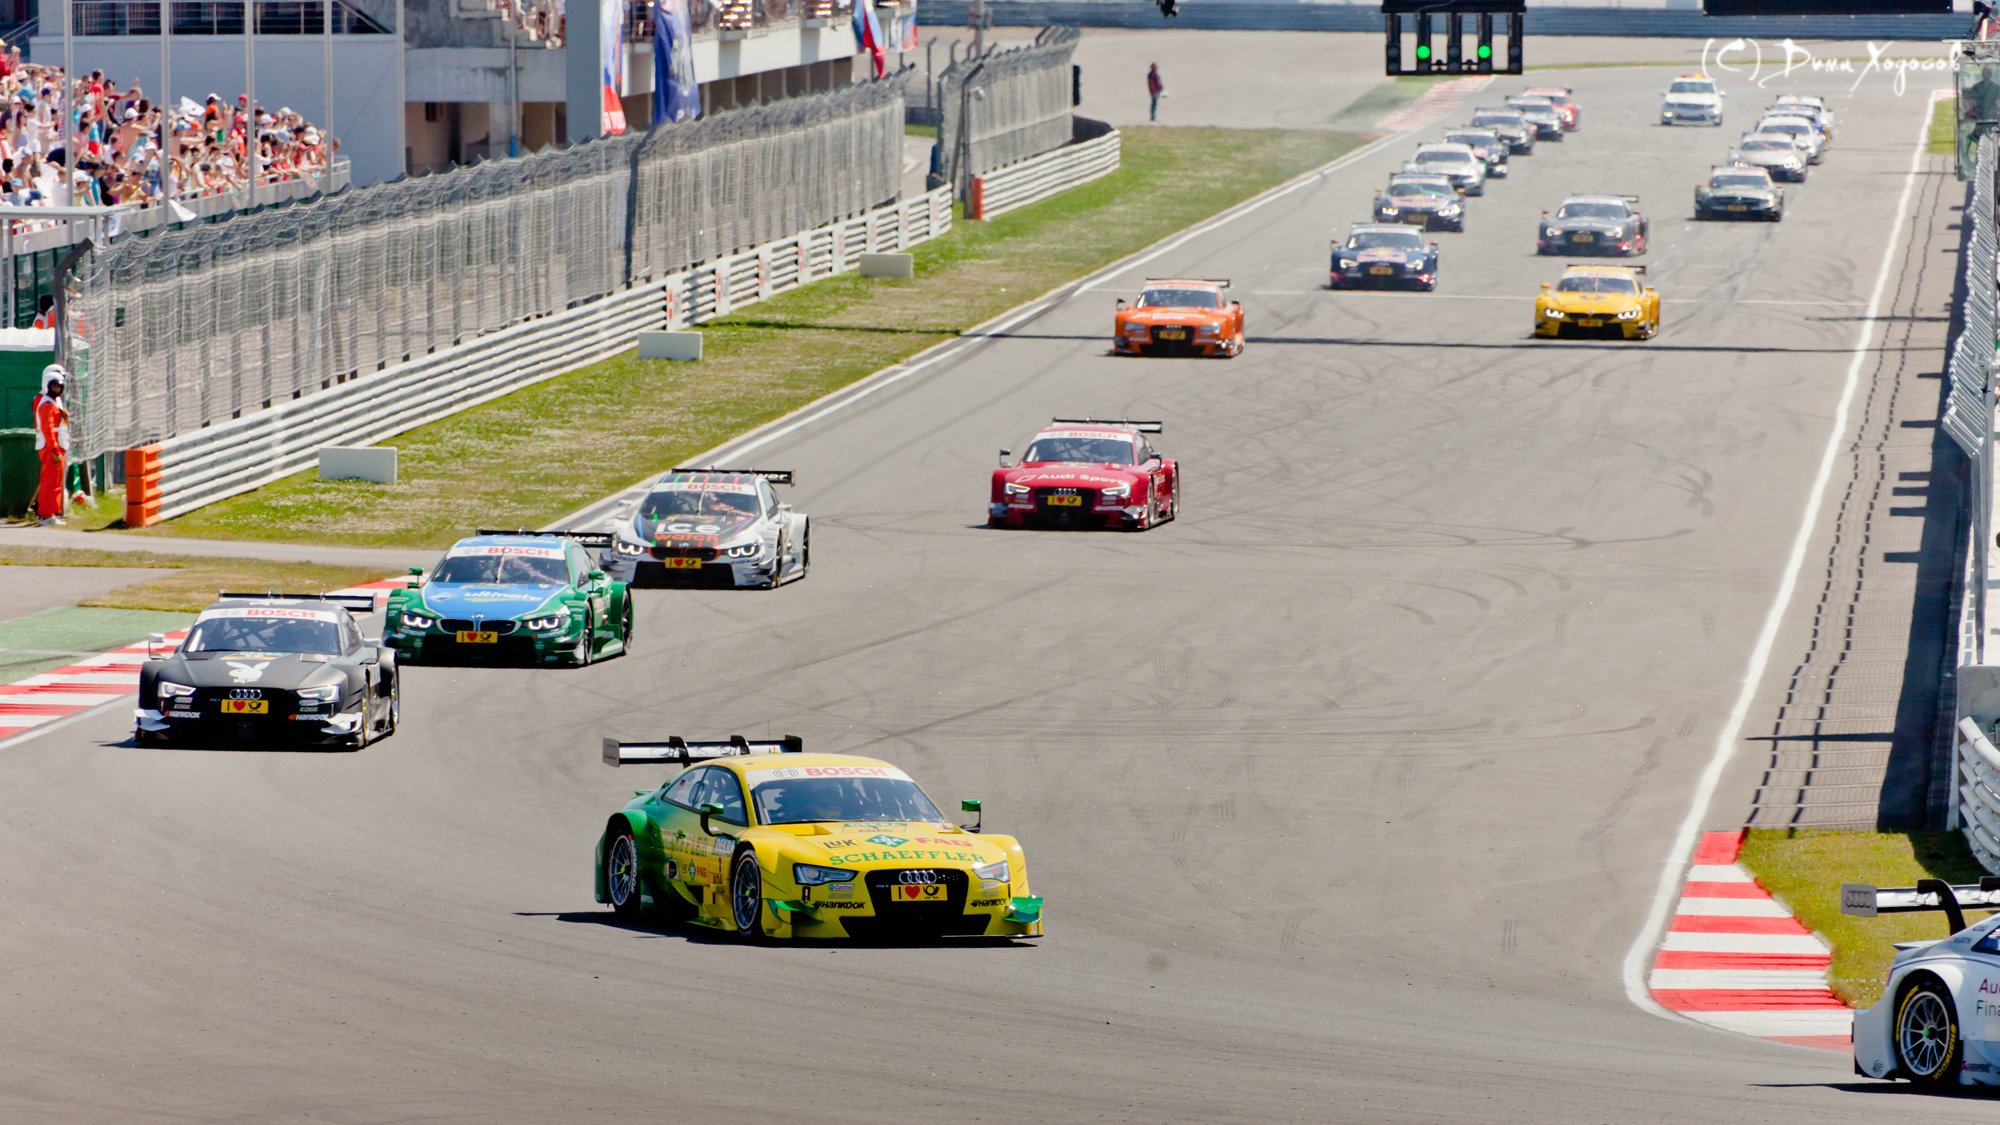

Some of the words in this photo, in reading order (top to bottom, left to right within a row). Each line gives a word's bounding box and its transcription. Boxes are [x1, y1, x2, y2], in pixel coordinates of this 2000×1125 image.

[687, 483, 743, 492] BOSCH
[487, 546, 550, 556] BOSCH
[246, 608, 316, 619] BOSCH
[804, 767, 889, 777] BOSCH
[914, 837, 973, 847] FAG
[828, 849, 989, 867] SCHAEFFLER
[1978, 978, 2000, 995] Au
